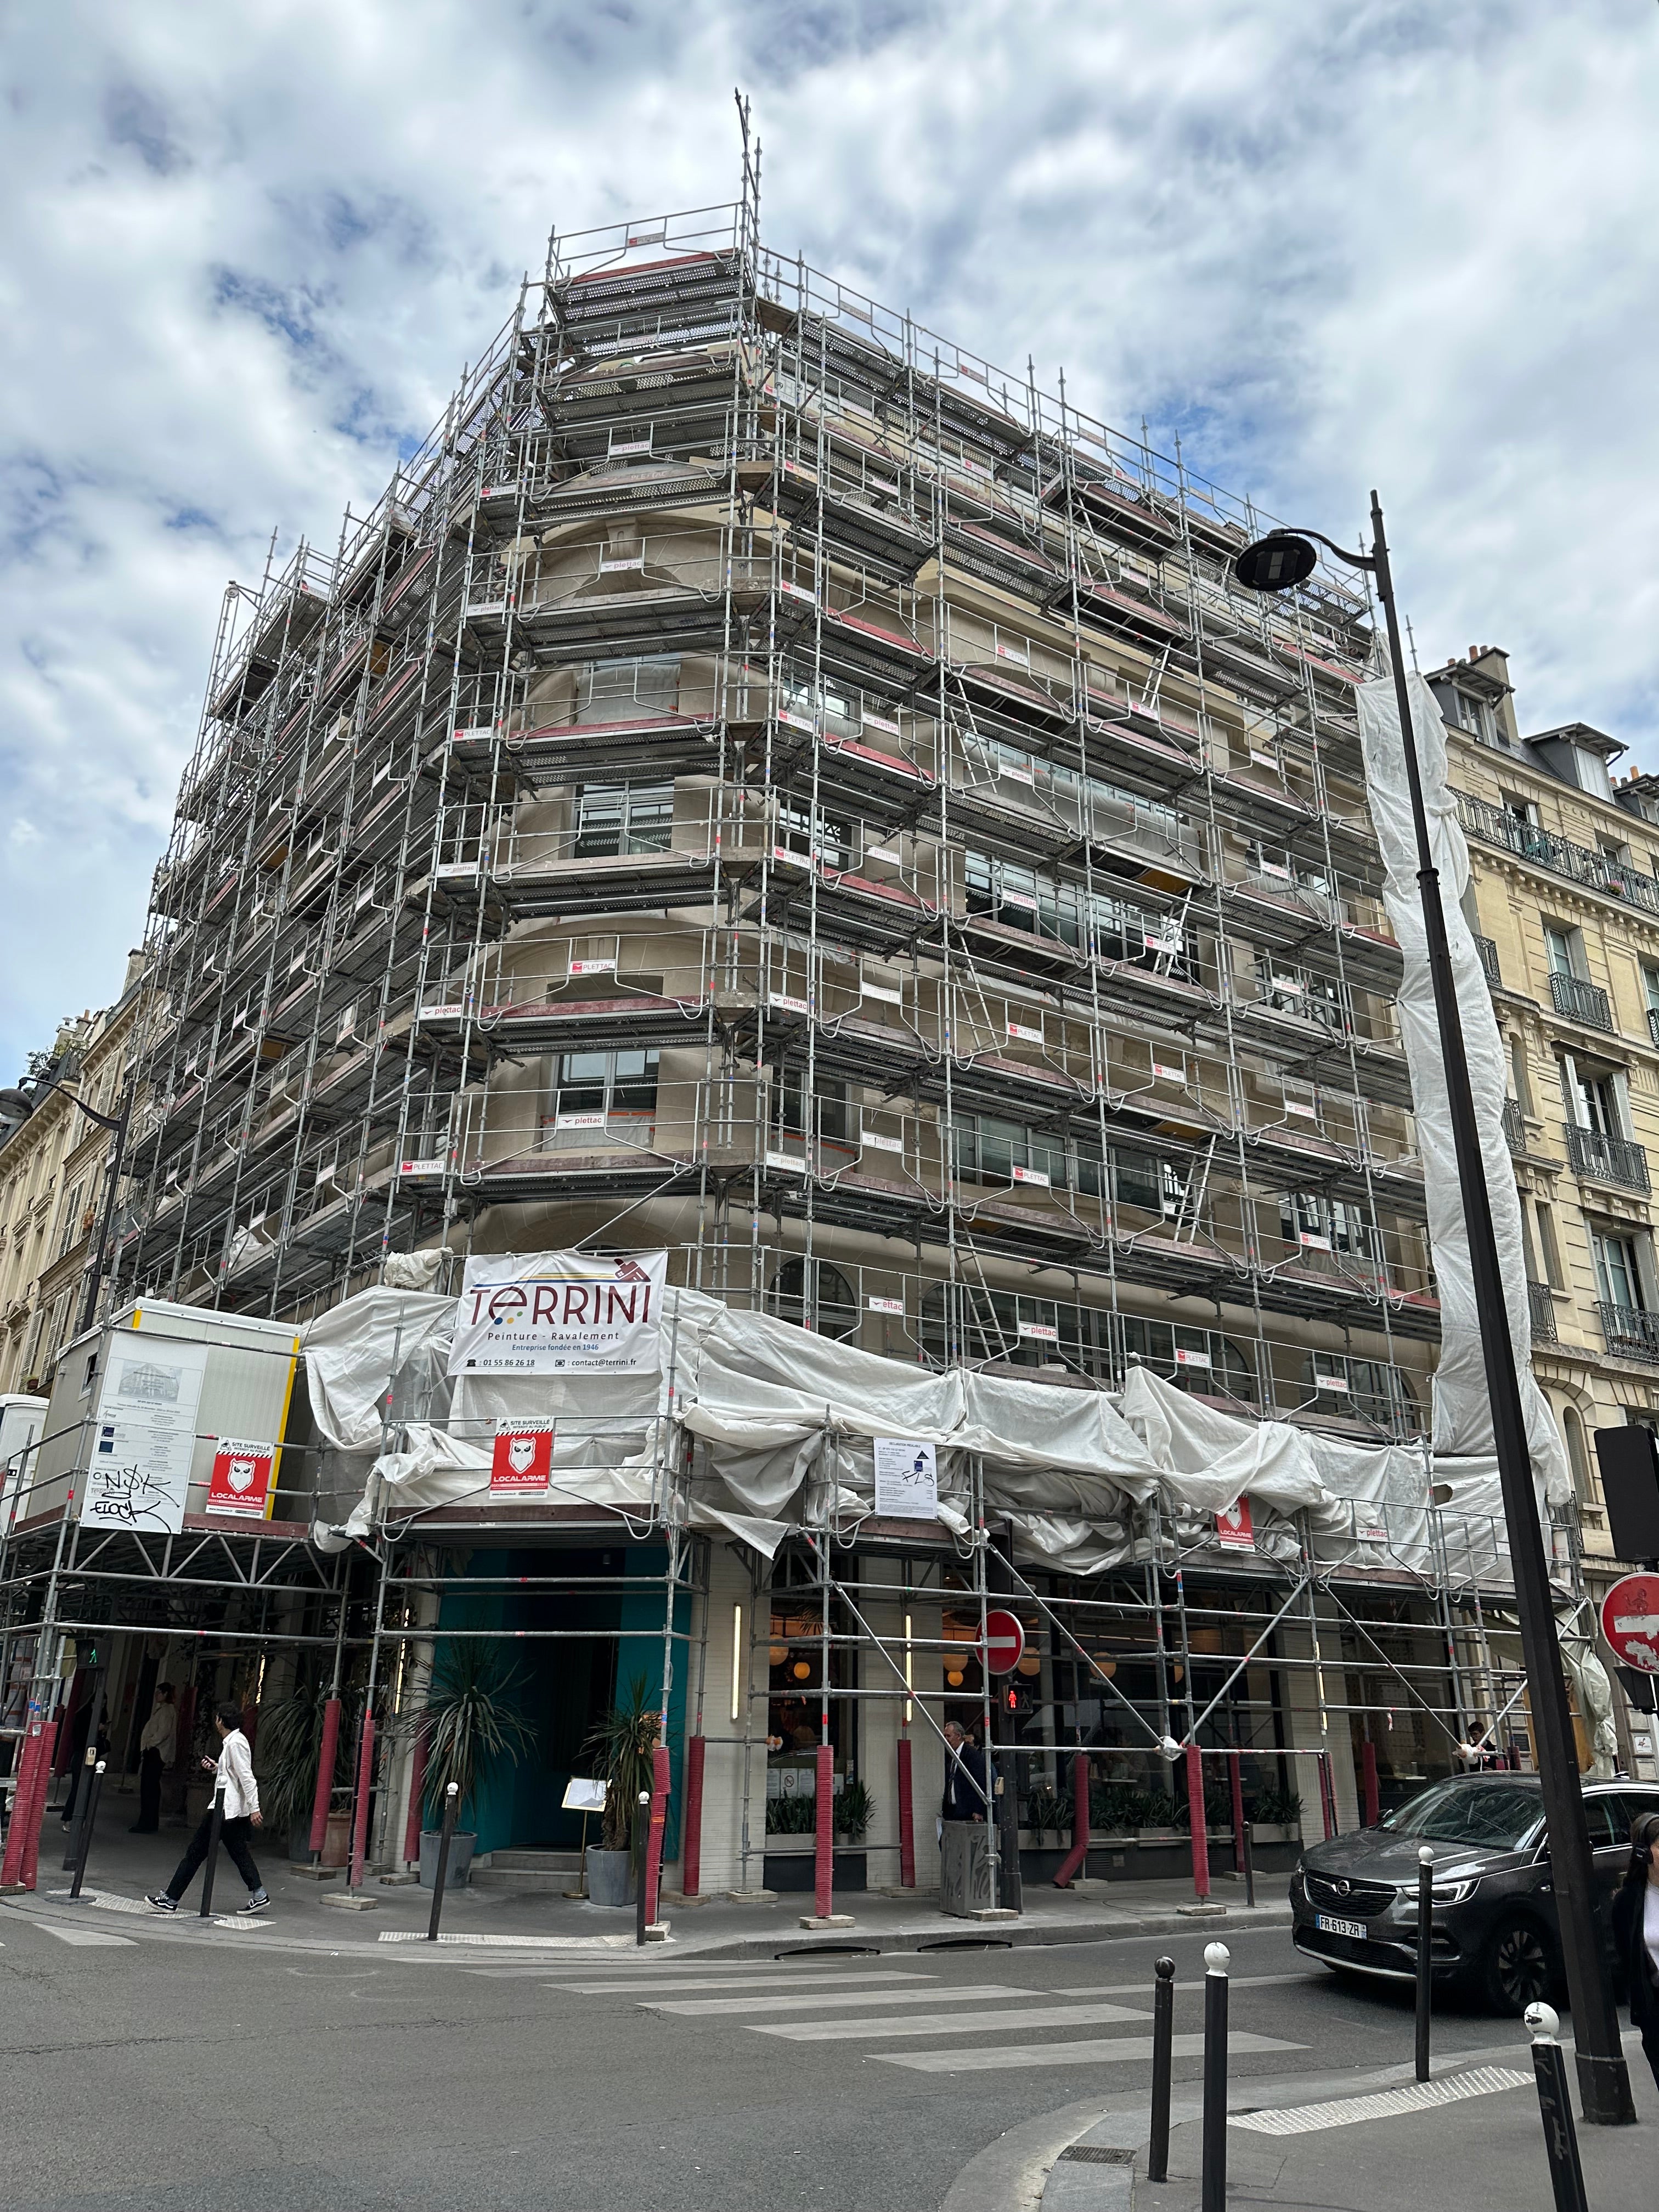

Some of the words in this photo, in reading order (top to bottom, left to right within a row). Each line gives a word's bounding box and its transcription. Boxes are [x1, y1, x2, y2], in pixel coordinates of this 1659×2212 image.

[622, 443, 650, 453] plettac
[614, 561, 641, 570] plettac
[791, 588, 814, 599] PLETTAC
[788, 716, 812, 729] PLETTAC
[874, 719, 898, 731] plettac
[1012, 771, 1031, 781] plettac
[785, 853, 809, 865] PLETTAC
[453, 865, 474, 874] plettac
[1014, 896, 1036, 906] plettac
[1154, 942, 1172, 950] PLETTAC
[783, 998, 807, 1008] plettac
[434, 1007, 461, 1015] plettac
[1018, 1029, 1040, 1039] PLETTAC
[1164, 1069, 1182, 1079] PLETTAC
[1295, 1105, 1313, 1115] plettac
[575, 1117, 601, 1126] plettac
[875, 1136, 900, 1147] plettac
[780, 1155, 803, 1167] plettac
[1024, 1173, 1047, 1183] PLETTAC
[1310, 1237, 1328, 1246] PLETTAC
[883, 1301, 903, 1311] ettac
[488, 1332, 538, 1340] Peinture
[551, 1331, 619, 1340] Ravalement
[1031, 1327, 1056, 1337] plettac
[571, 1358, 637, 1367] contact@terrini.fr
[1186, 1355, 1207, 1363] PLETTAC
[1327, 1379, 1346, 1388] plettac
[211, 1492, 263, 1503] LOCALARME
[1220, 1530, 1251, 1538] LOCALARME
[1367, 1529, 1387, 1538] plettac
